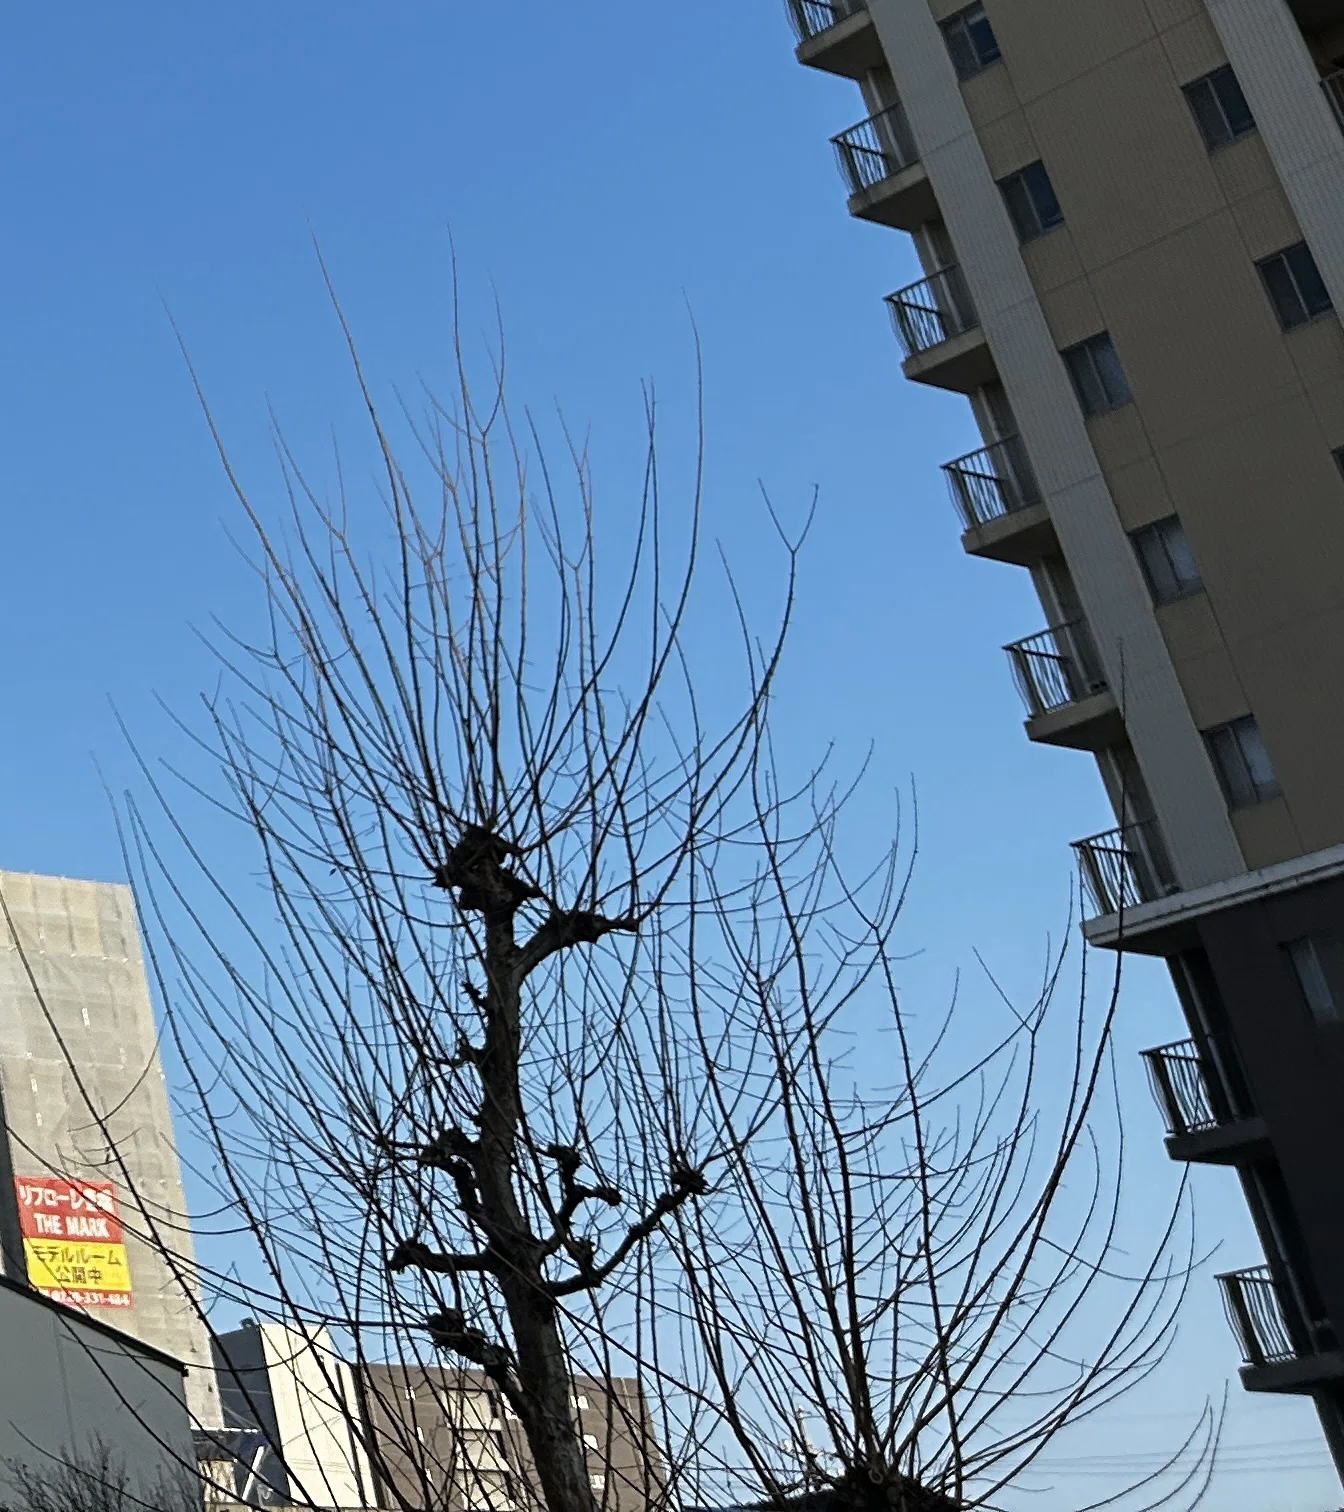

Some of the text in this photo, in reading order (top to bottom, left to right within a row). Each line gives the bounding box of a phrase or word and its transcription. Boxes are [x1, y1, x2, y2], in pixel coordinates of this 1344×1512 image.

[33, 1213, 110, 1238] THE MARK
[32, 1244, 122, 1266] モデルルーム
[55, 1264, 103, 1285] 公開中
